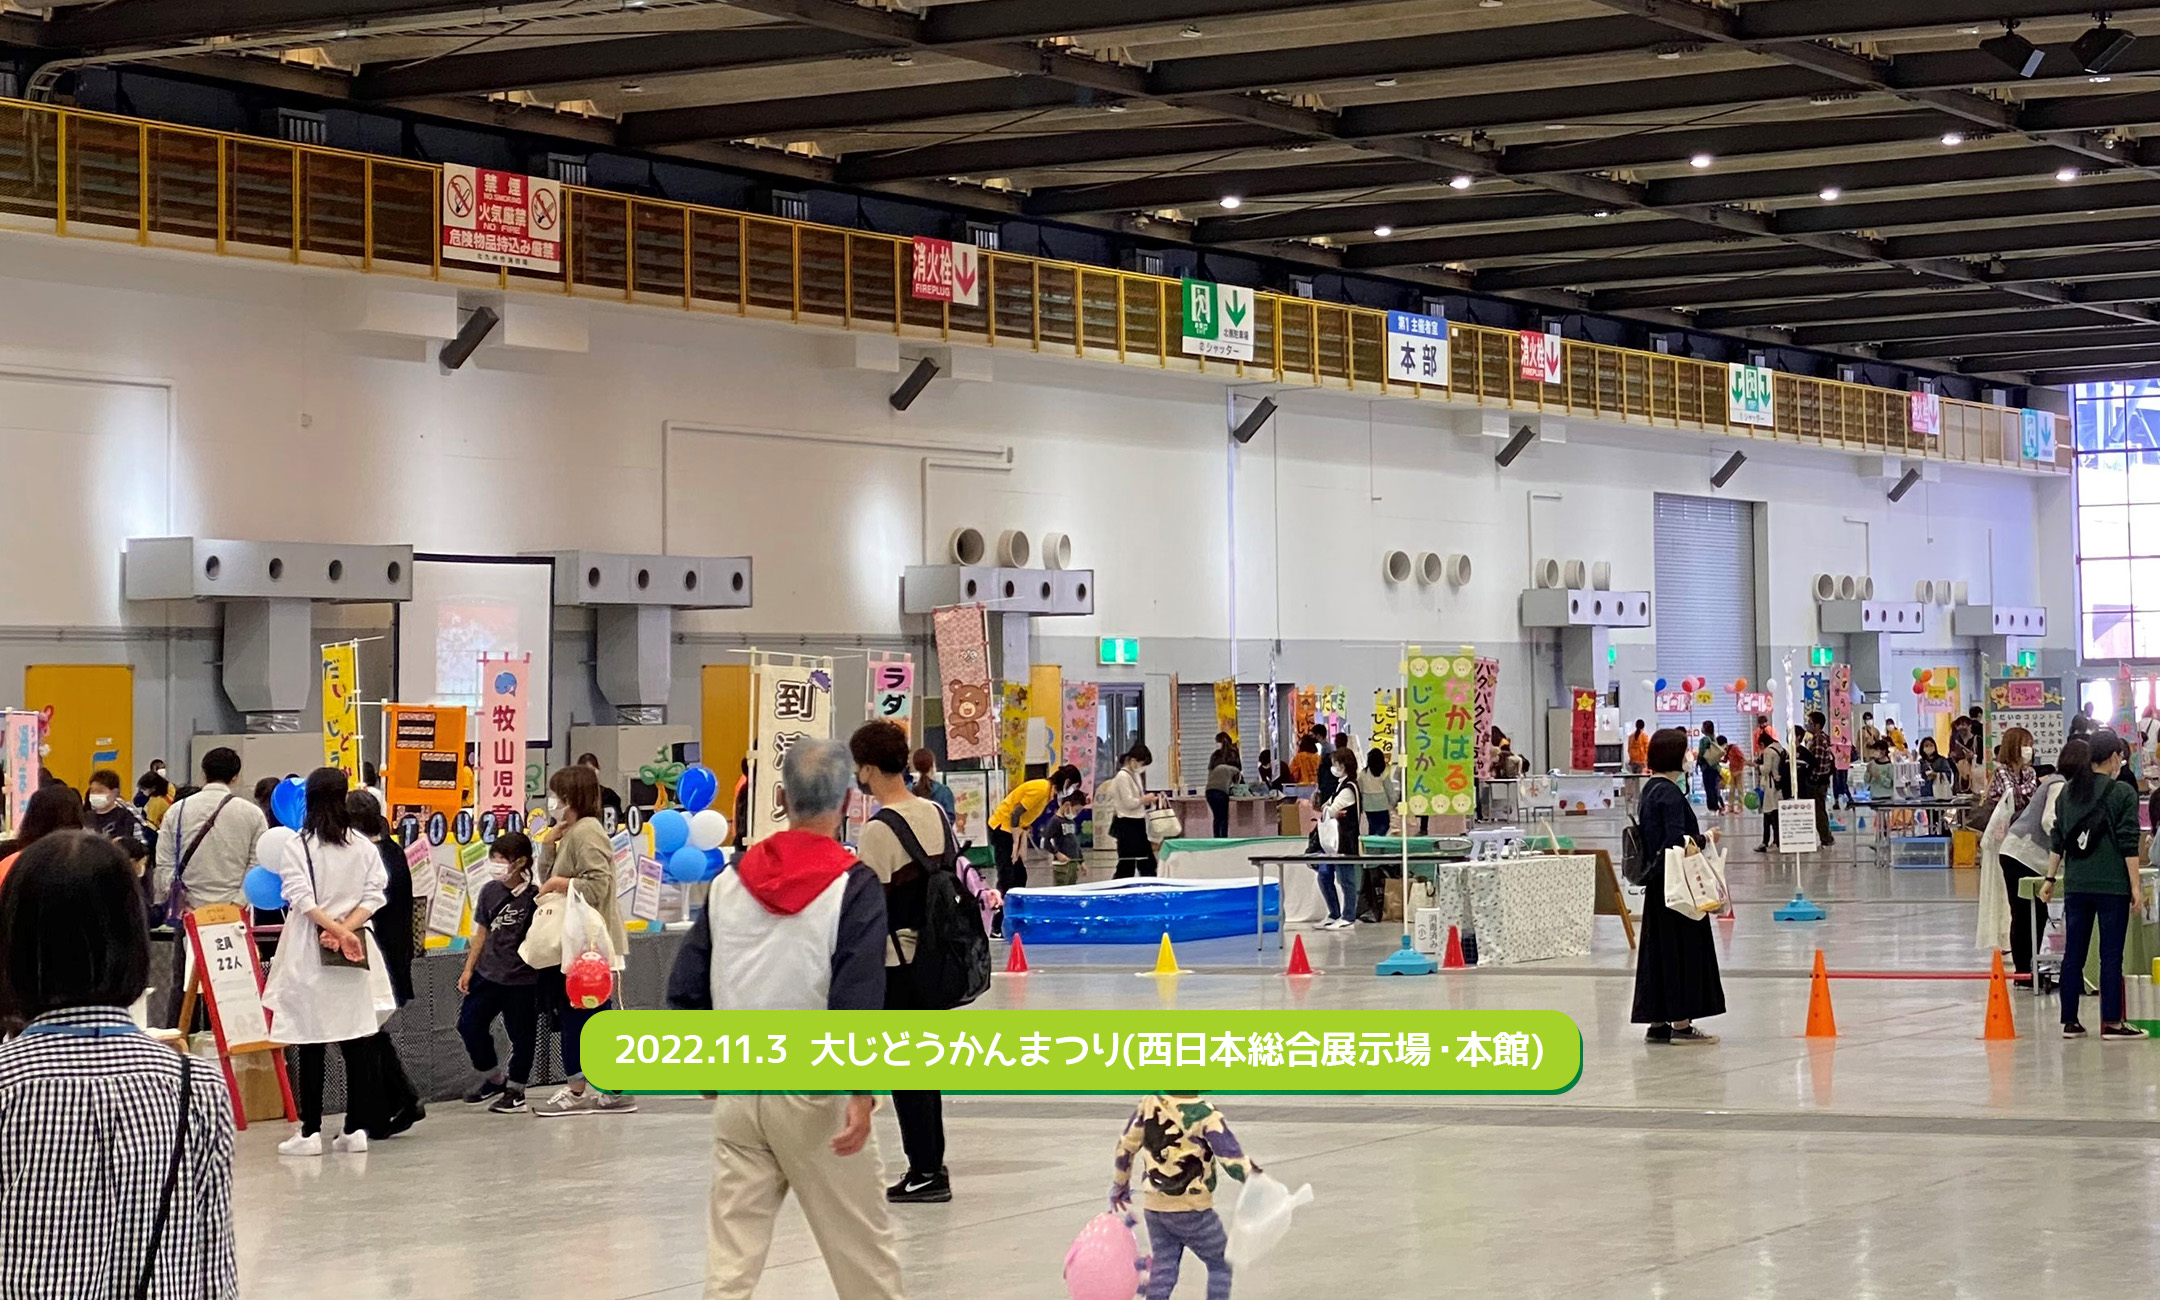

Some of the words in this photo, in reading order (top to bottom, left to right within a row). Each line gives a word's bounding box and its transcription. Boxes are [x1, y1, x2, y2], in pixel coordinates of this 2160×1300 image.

[483, 173, 521, 197] 禁煙
[478, 203, 527, 228] 火気厳禁
[482, 222, 497, 231] NO
[500, 224, 521, 235] FIRE
[449, 228, 554, 259] 危険物品持込み厳禁
[913, 241, 952, 286] 消火栓
[915, 283, 951, 297] FIREPLUG
[1397, 315, 1439, 336] 第1主催者室
[1400, 340, 1438, 377] 本部
[1412, 685, 1437, 793] じどうかん
[1442, 677, 1473, 791] なかはる
[215, 936, 234, 951] 定員
[217, 955, 243, 971] 22人
